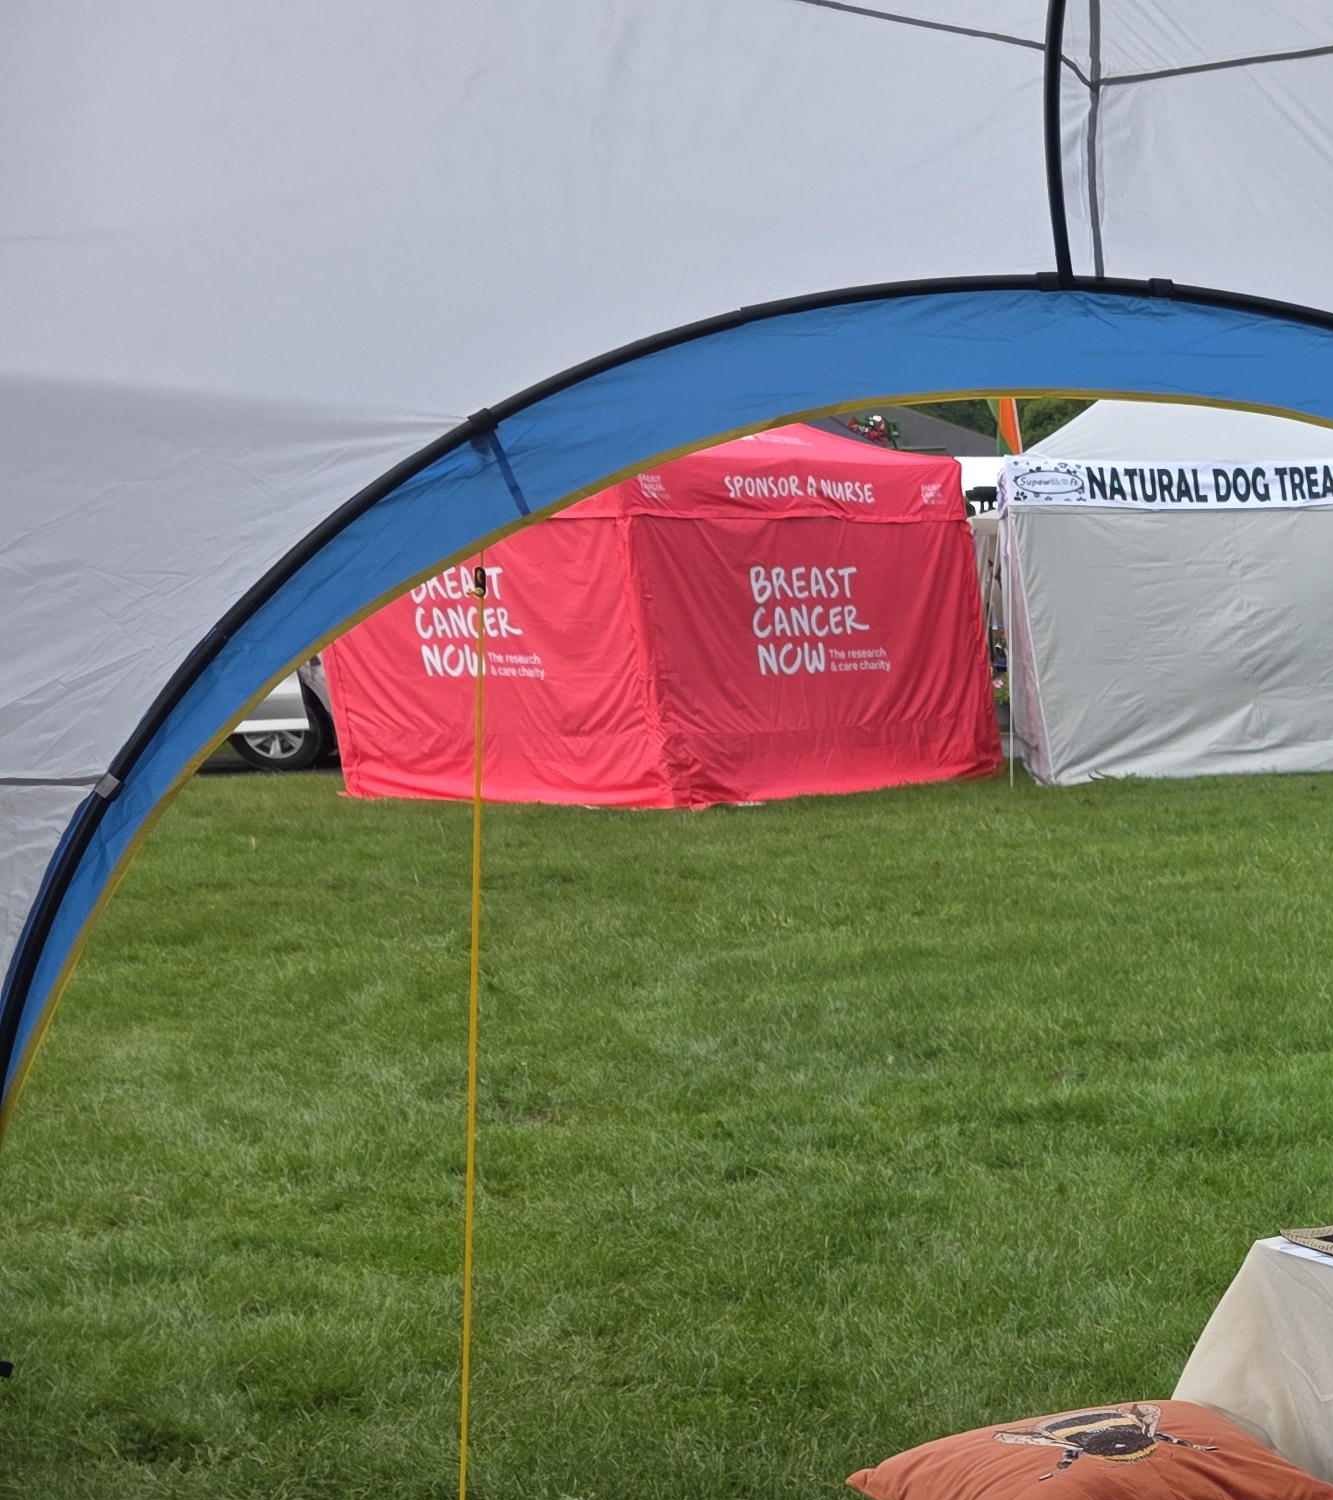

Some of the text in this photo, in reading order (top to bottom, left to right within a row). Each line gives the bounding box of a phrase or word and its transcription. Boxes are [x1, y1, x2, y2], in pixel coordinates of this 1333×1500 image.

[724, 475, 875, 504] SPONSOR A NURSE
[1086, 466, 1208, 503] NATURAL
[1212, 467, 1270, 502] DOG
[410, 566, 503, 604] REAT
[750, 566, 857, 604] BREAST
[415, 604, 523, 640] CANCER
[752, 604, 870, 639] CANCER
[421, 643, 486, 677] NOW
[487, 652, 541, 665] The research
[757, 642, 825, 676] NOW
[828, 647, 886, 660] The research
[838, 661, 858, 672] care
[859, 659, 891, 672] charity
[498, 666, 516, 677] care
[518, 666, 545, 681] charity
